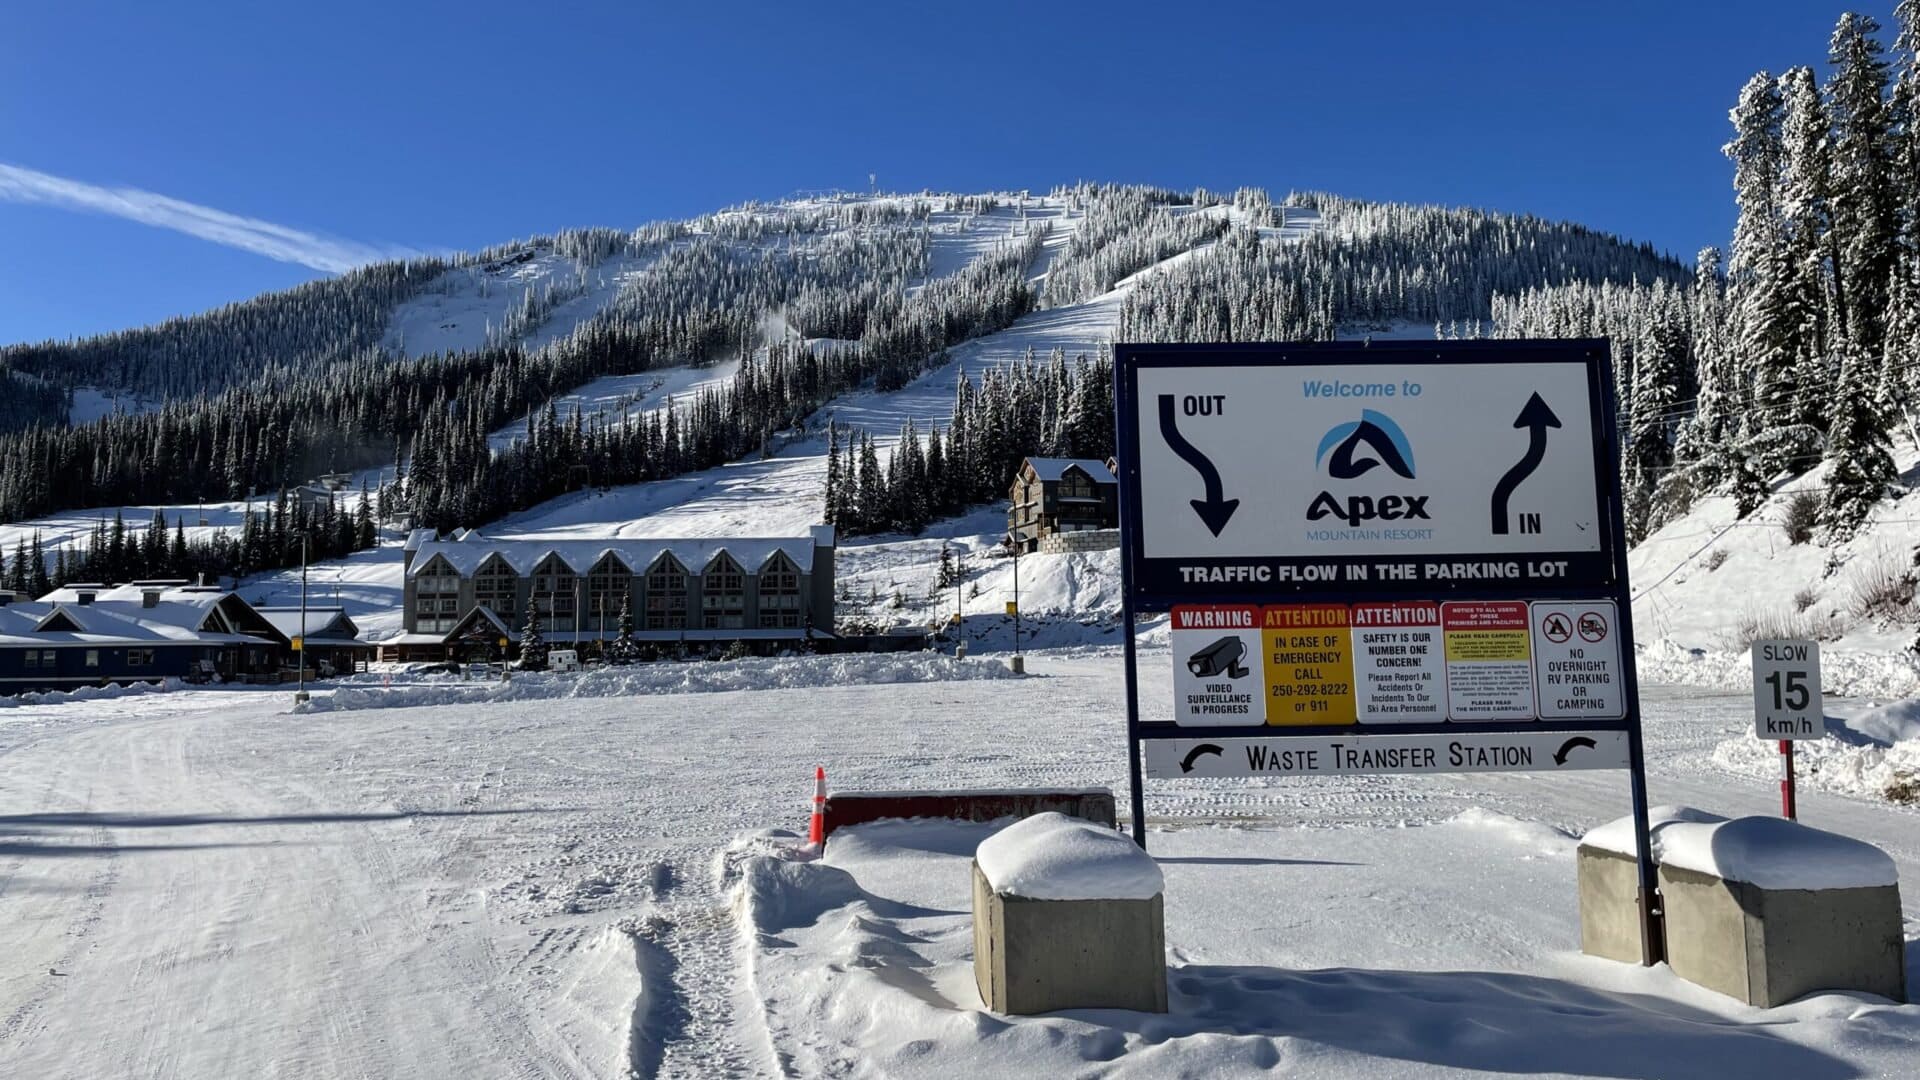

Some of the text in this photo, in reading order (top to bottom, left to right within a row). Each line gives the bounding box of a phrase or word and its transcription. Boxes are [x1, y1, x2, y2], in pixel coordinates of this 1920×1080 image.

[1303, 380, 1422, 397] Welcome to
[1183, 396, 1226, 416] OUT
[1306, 490, 1432, 527] Apex
[1519, 513, 1541, 534] IN
[1306, 528, 1434, 541] MOUNTAIN RESORT
[1180, 561, 1568, 582] TRAFFIC FLOW IN THE PARKING LOT
[1180, 610, 1252, 627] WARNING
[1265, 609, 1346, 625] ATTENTION
[1356, 607, 1436, 624] ATTENTION
[1275, 636, 1338, 648] IN CASE OF
[1363, 633, 1431, 643] SAFETY IS OUR
[1368, 645, 1427, 655] NUMBER ONE
[1569, 648, 1584, 659] NO
[1763, 645, 1808, 661] SLOW
[1273, 652, 1341, 664] EMERGENCY
[1376, 657, 1422, 667] CONCERN!
[1548, 661, 1607, 672] OVERNIGHT
[1295, 669, 1323, 680] CALL
[1368, 672, 1431, 683] Please Report All
[1548, 673, 1610, 684] RV PARKING
[1206, 684, 1232, 693] VIDEO
[1272, 683, 1348, 696] 250-292-8222
[1377, 683, 1423, 692] Accidents Or
[1572, 686, 1587, 696] OR
[1765, 670, 1810, 711] 15
[1187, 694, 1252, 703] SURVEILLANCE
[1371, 694, 1430, 702] Incidents To Our
[1191, 704, 1249, 714] IN PROGRESS
[1295, 701, 1328, 712] or 911
[1368, 704, 1436, 713] Ski Area Personnel
[1557, 699, 1605, 710] CAMPING
[1767, 716, 1813, 736] km/h
[1246, 741, 1532, 771] WASTE TRANSFER STATION
